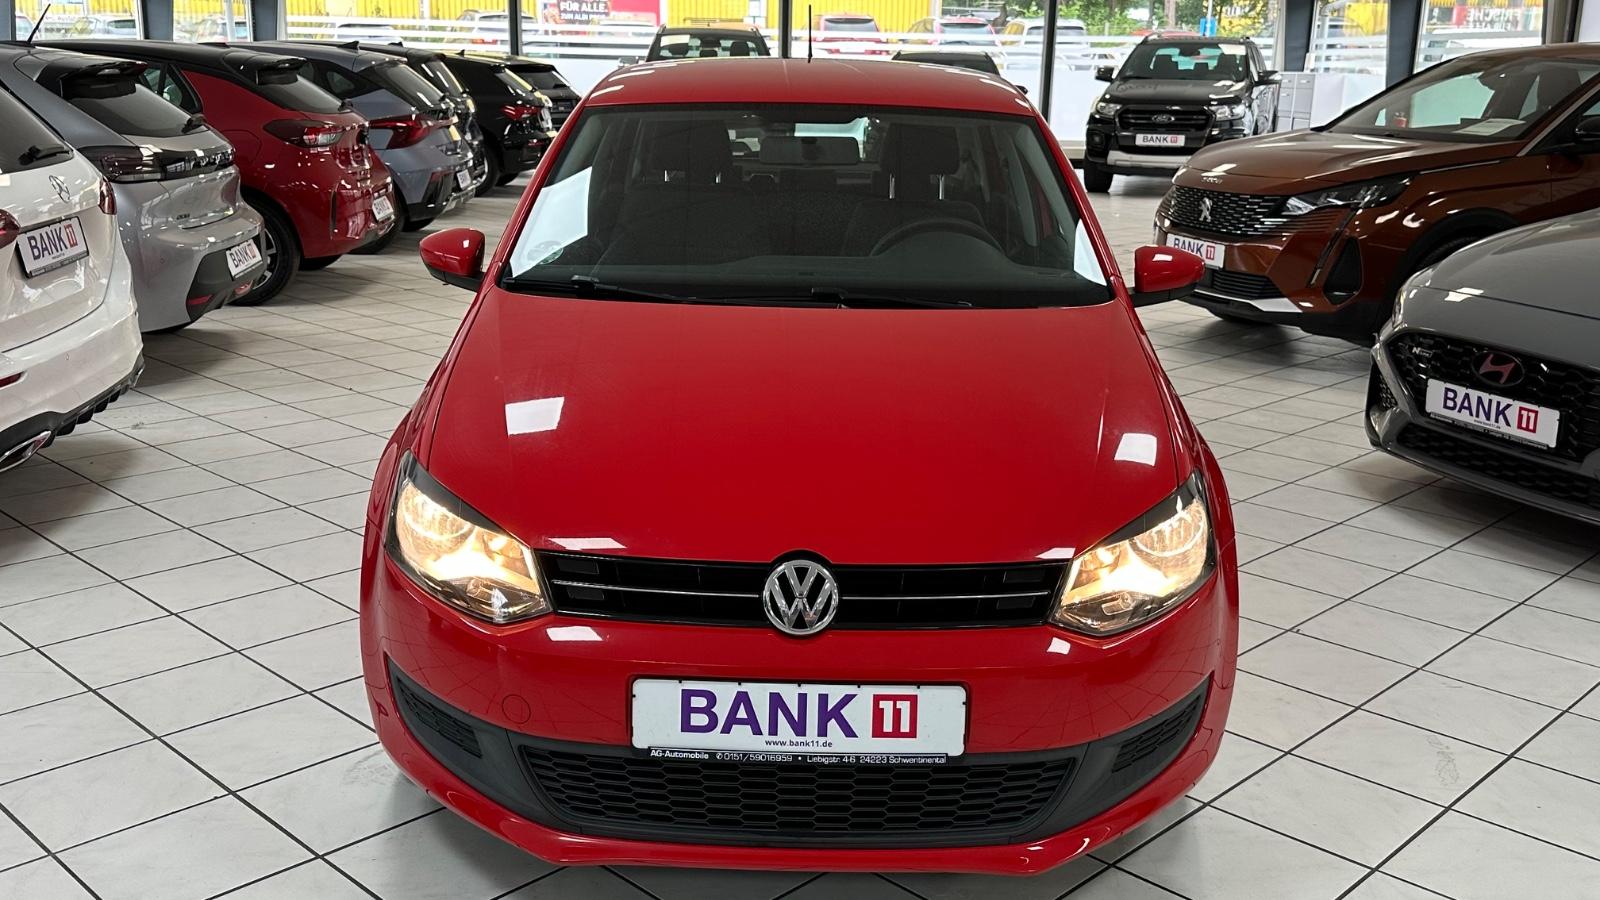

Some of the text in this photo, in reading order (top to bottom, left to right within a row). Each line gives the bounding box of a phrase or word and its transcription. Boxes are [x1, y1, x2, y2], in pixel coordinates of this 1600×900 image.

[560, 1, 579, 11] FÜR
[1142, 136, 1169, 144] BANK
[27, 226, 68, 261] BANK
[1173, 238, 1204, 258] BANK
[230, 246, 252, 268] BANK
[1442, 387, 1513, 427] BANK
[1519, 408, 1538, 431] 11
[680, 688, 914, 738] BANK 11
[764, 739, 833, 748] www.bank11.de
[650, 749, 709, 760] AG-Automobile
[859, 756, 887, 765] 24223
[888, 756, 947, 765] Schwentinental
